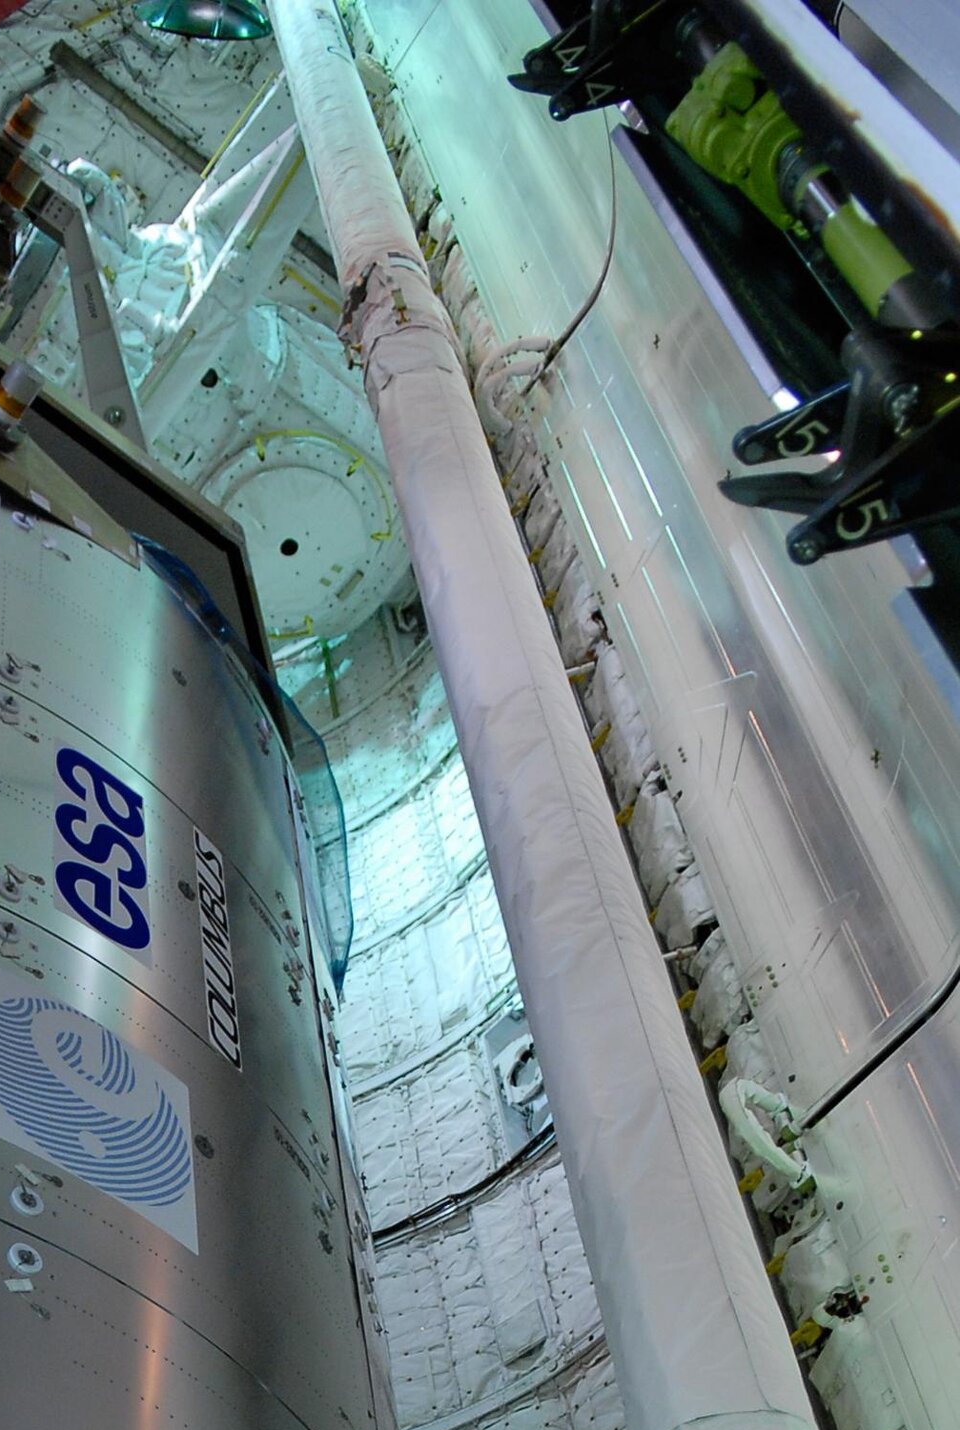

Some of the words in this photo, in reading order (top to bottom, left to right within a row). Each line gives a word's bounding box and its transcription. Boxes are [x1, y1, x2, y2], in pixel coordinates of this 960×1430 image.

[774, 403, 830, 459] 15
[836, 479, 889, 541] 15
[55, 747, 151, 950] esa
[194, 829, 242, 1070] COLUMBUS
